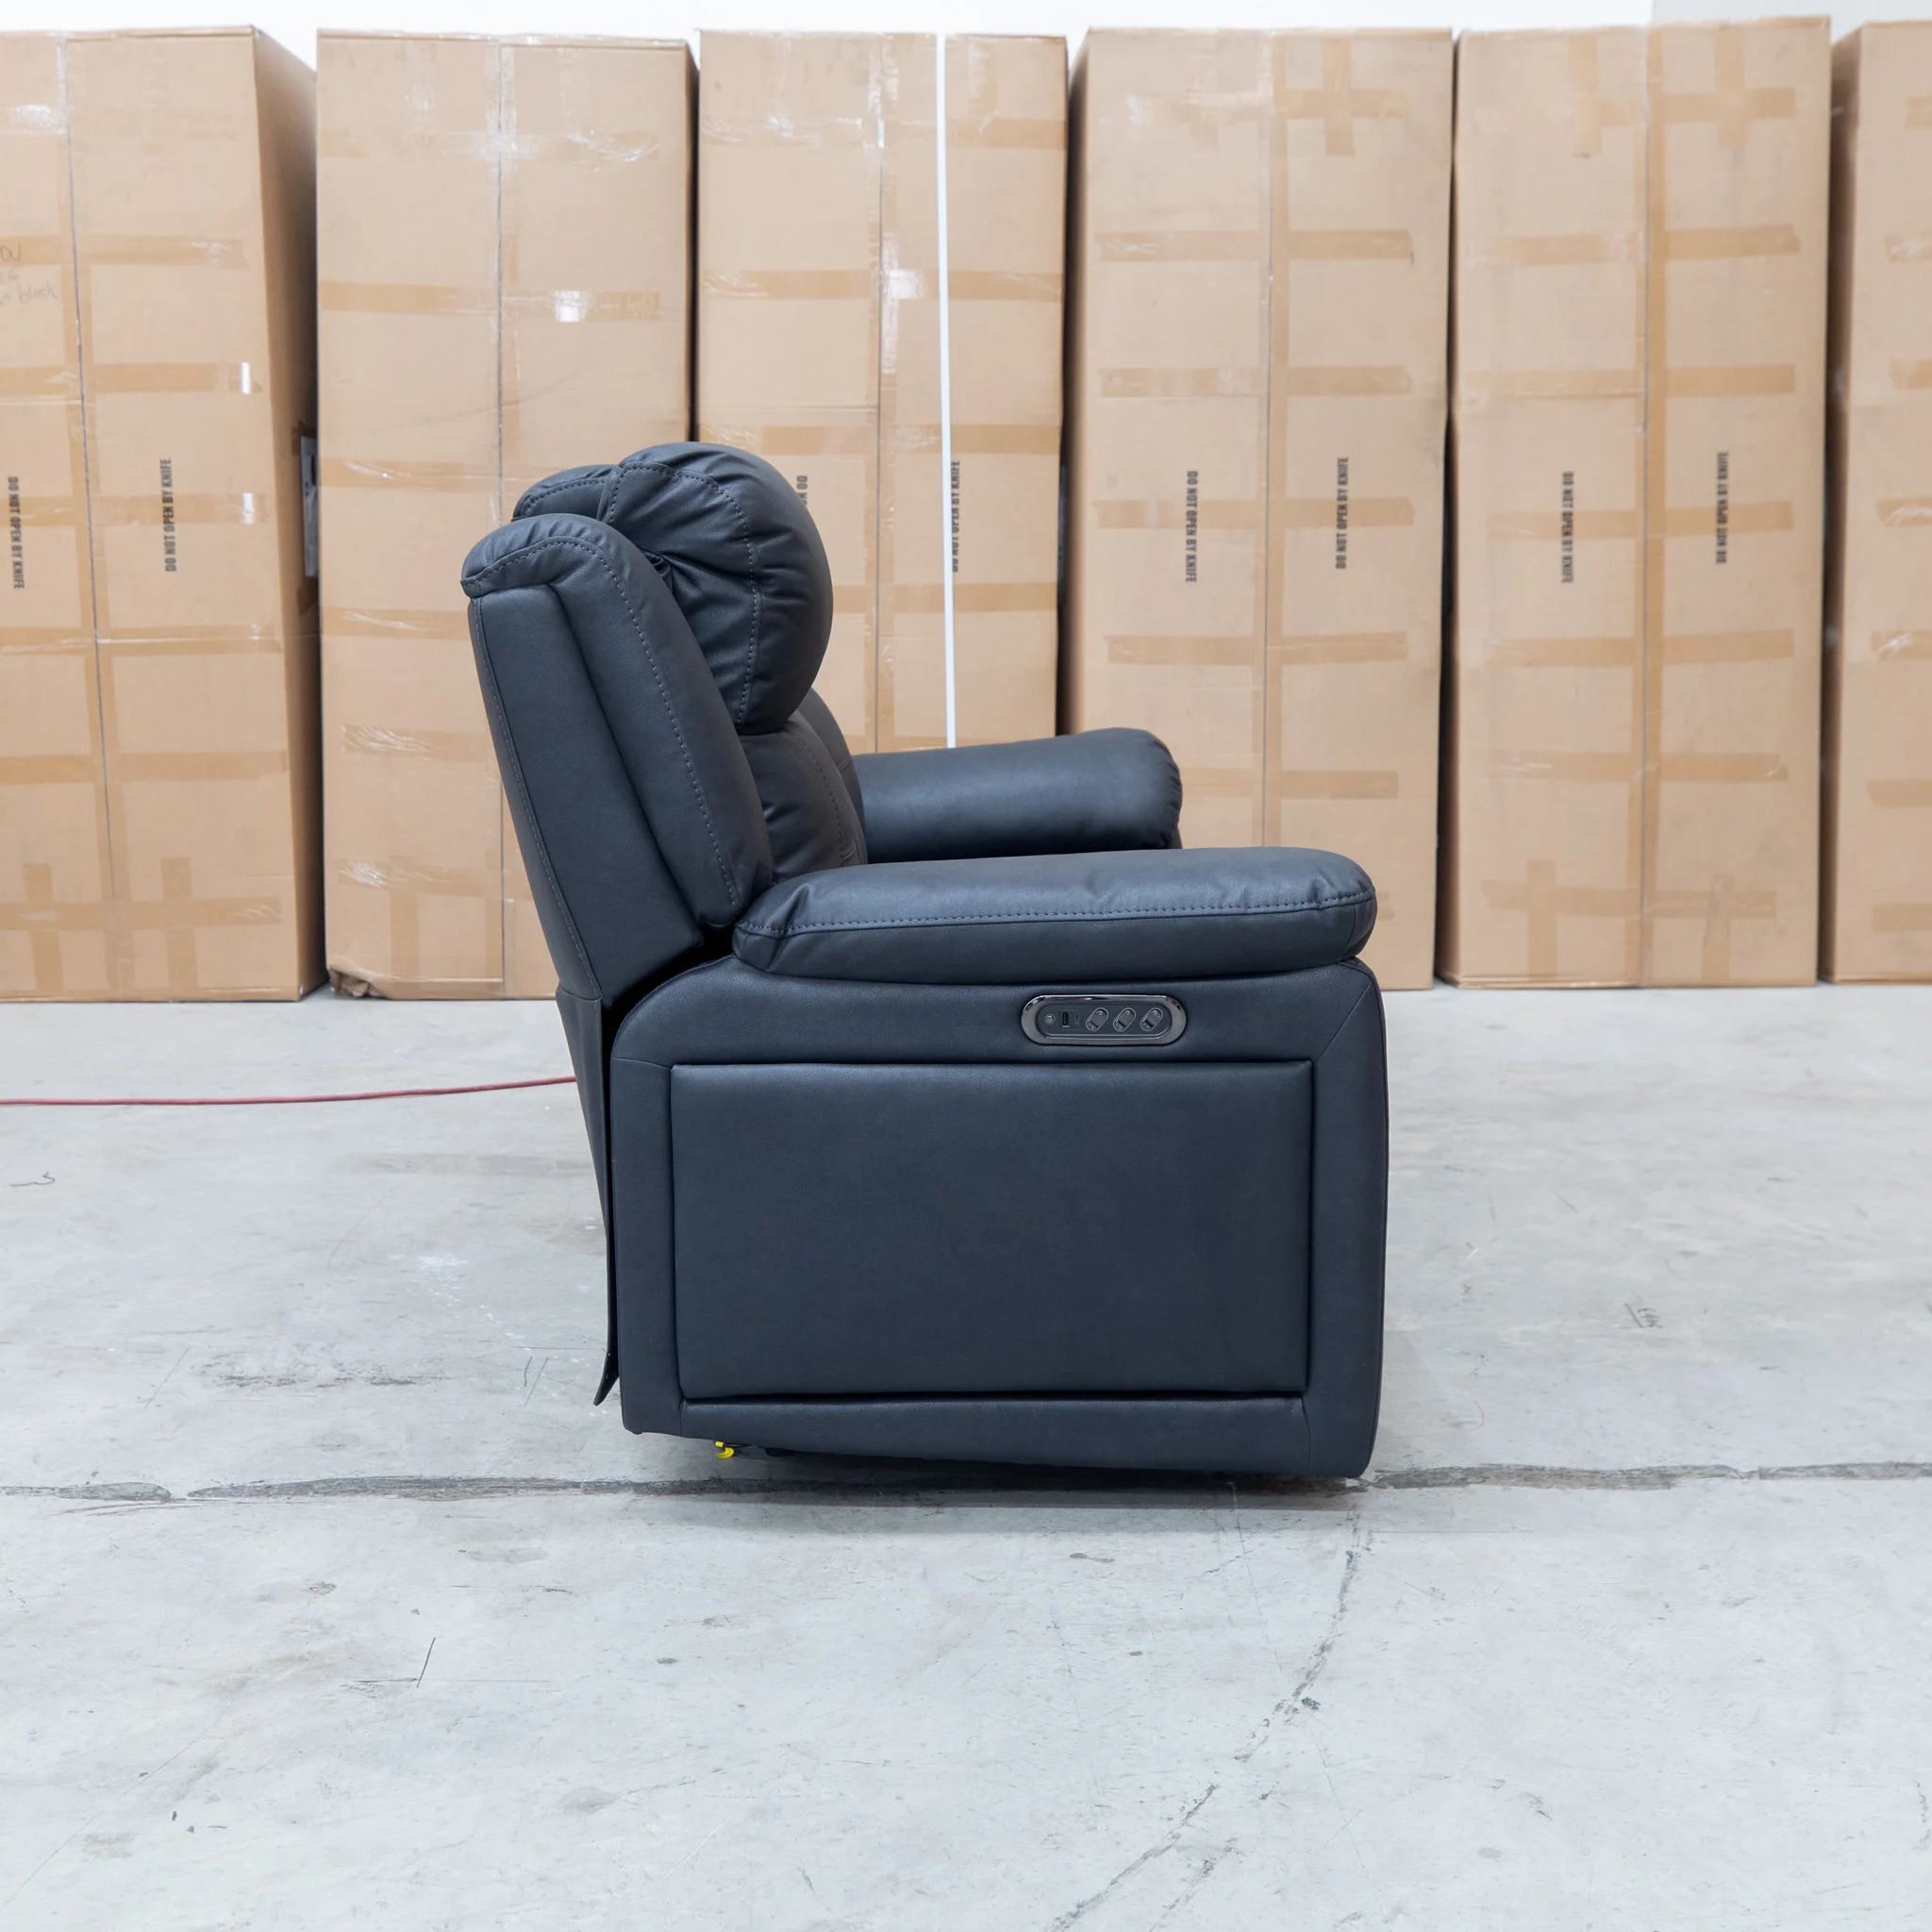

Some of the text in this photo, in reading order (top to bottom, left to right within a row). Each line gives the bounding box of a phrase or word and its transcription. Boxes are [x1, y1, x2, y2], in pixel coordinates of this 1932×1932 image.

[8, 476, 25, 590] DO NOT OPEN BY KNIFE
[160, 459, 176, 572] DO NOT OPEN BY KNIFE
[1186, 471, 1198, 582] DO NOT OPEN BY KNIFE
[1336, 458, 1348, 569] DO NOT OPEN BY KNIFE
